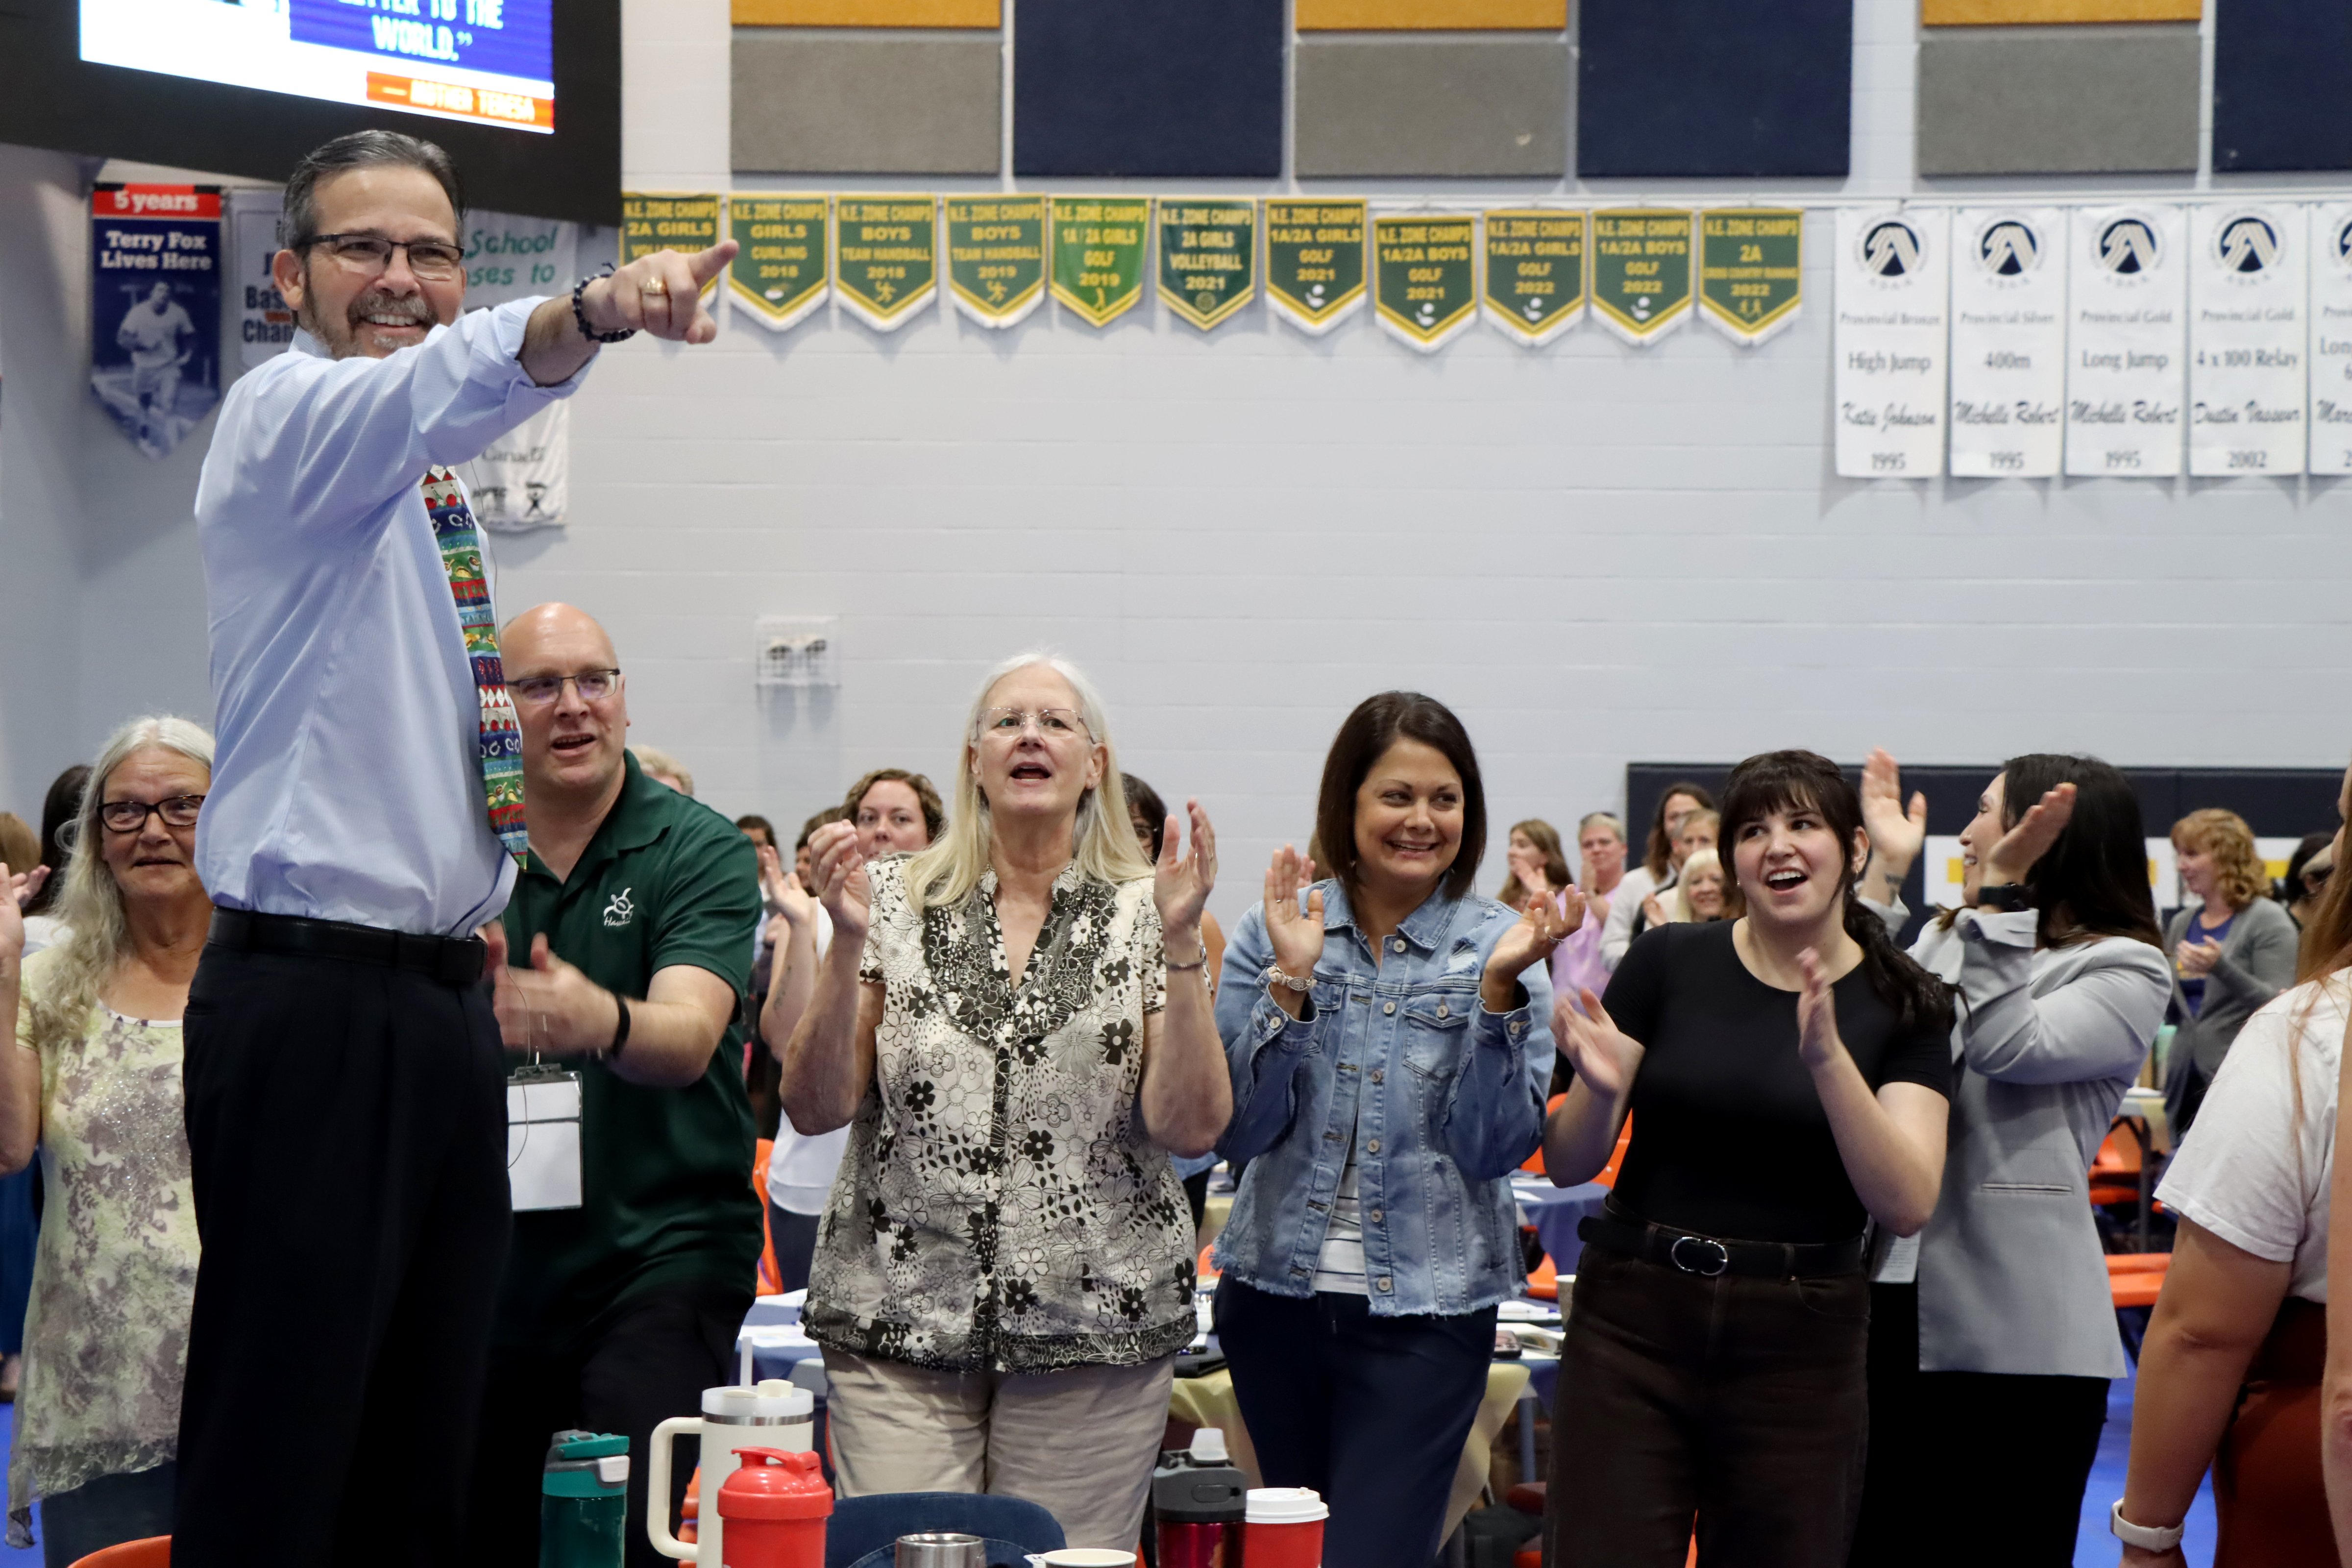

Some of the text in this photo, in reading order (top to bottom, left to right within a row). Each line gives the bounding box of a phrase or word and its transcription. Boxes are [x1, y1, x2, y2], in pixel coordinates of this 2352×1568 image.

[465, 0, 504, 29] THE
[113, 190, 199, 214] 5 years
[628, 221, 713, 236] 2A GIRLS
[750, 224, 808, 239] GIRLS
[861, 226, 912, 241] BOYS
[972, 225, 1022, 241] BOYS
[1315, 228, 1362, 243] GIRLS
[105, 230, 207, 252] Terry Fox
[463, 225, 559, 260] School
[1182, 231, 1235, 248] 2A GIRLS
[1427, 246, 1469, 261] BOYS
[1534, 241, 1581, 256] GIRLS
[1645, 241, 1686, 255] BOYS
[1740, 245, 1763, 262] 2A
[101, 250, 213, 270] Lives Here
[1083, 250, 1115, 267] GOLF
[1169, 253, 1243, 271] VOLLEYBALL
[1299, 249, 1334, 264] GOLF
[466, 263, 556, 288] ses to
[1297, 268, 1336, 282] 2021
[1408, 268, 1443, 283] GOLF
[1517, 262, 1552, 276] GOLF
[1625, 261, 1660, 276] GOLF
[1079, 272, 1121, 287] 2019
[1185, 276, 1225, 291] 2021
[1623, 280, 1663, 294] 2022
[1406, 287, 1445, 300] 2021
[1515, 281, 1555, 295] 2022
[1731, 284, 1771, 296] 2022
[245, 285, 290, 309] Bas
[2143, 308, 2173, 324] Gold
[2265, 307, 2295, 322] Gold
[2319, 336, 2352, 357] Lon
[1848, 350, 1932, 375] High Jump
[1984, 351, 2031, 369] 400m
[2082, 349, 2169, 373] Long Jump
[2197, 346, 2297, 371] 4 x 100 Relay
[1871, 452, 1906, 470] 1995
[1989, 451, 2024, 470] 1995
[2106, 450, 2141, 469] 1995
[2228, 450, 2268, 469] 2002
[603, 915, 631, 927] Hawaii
